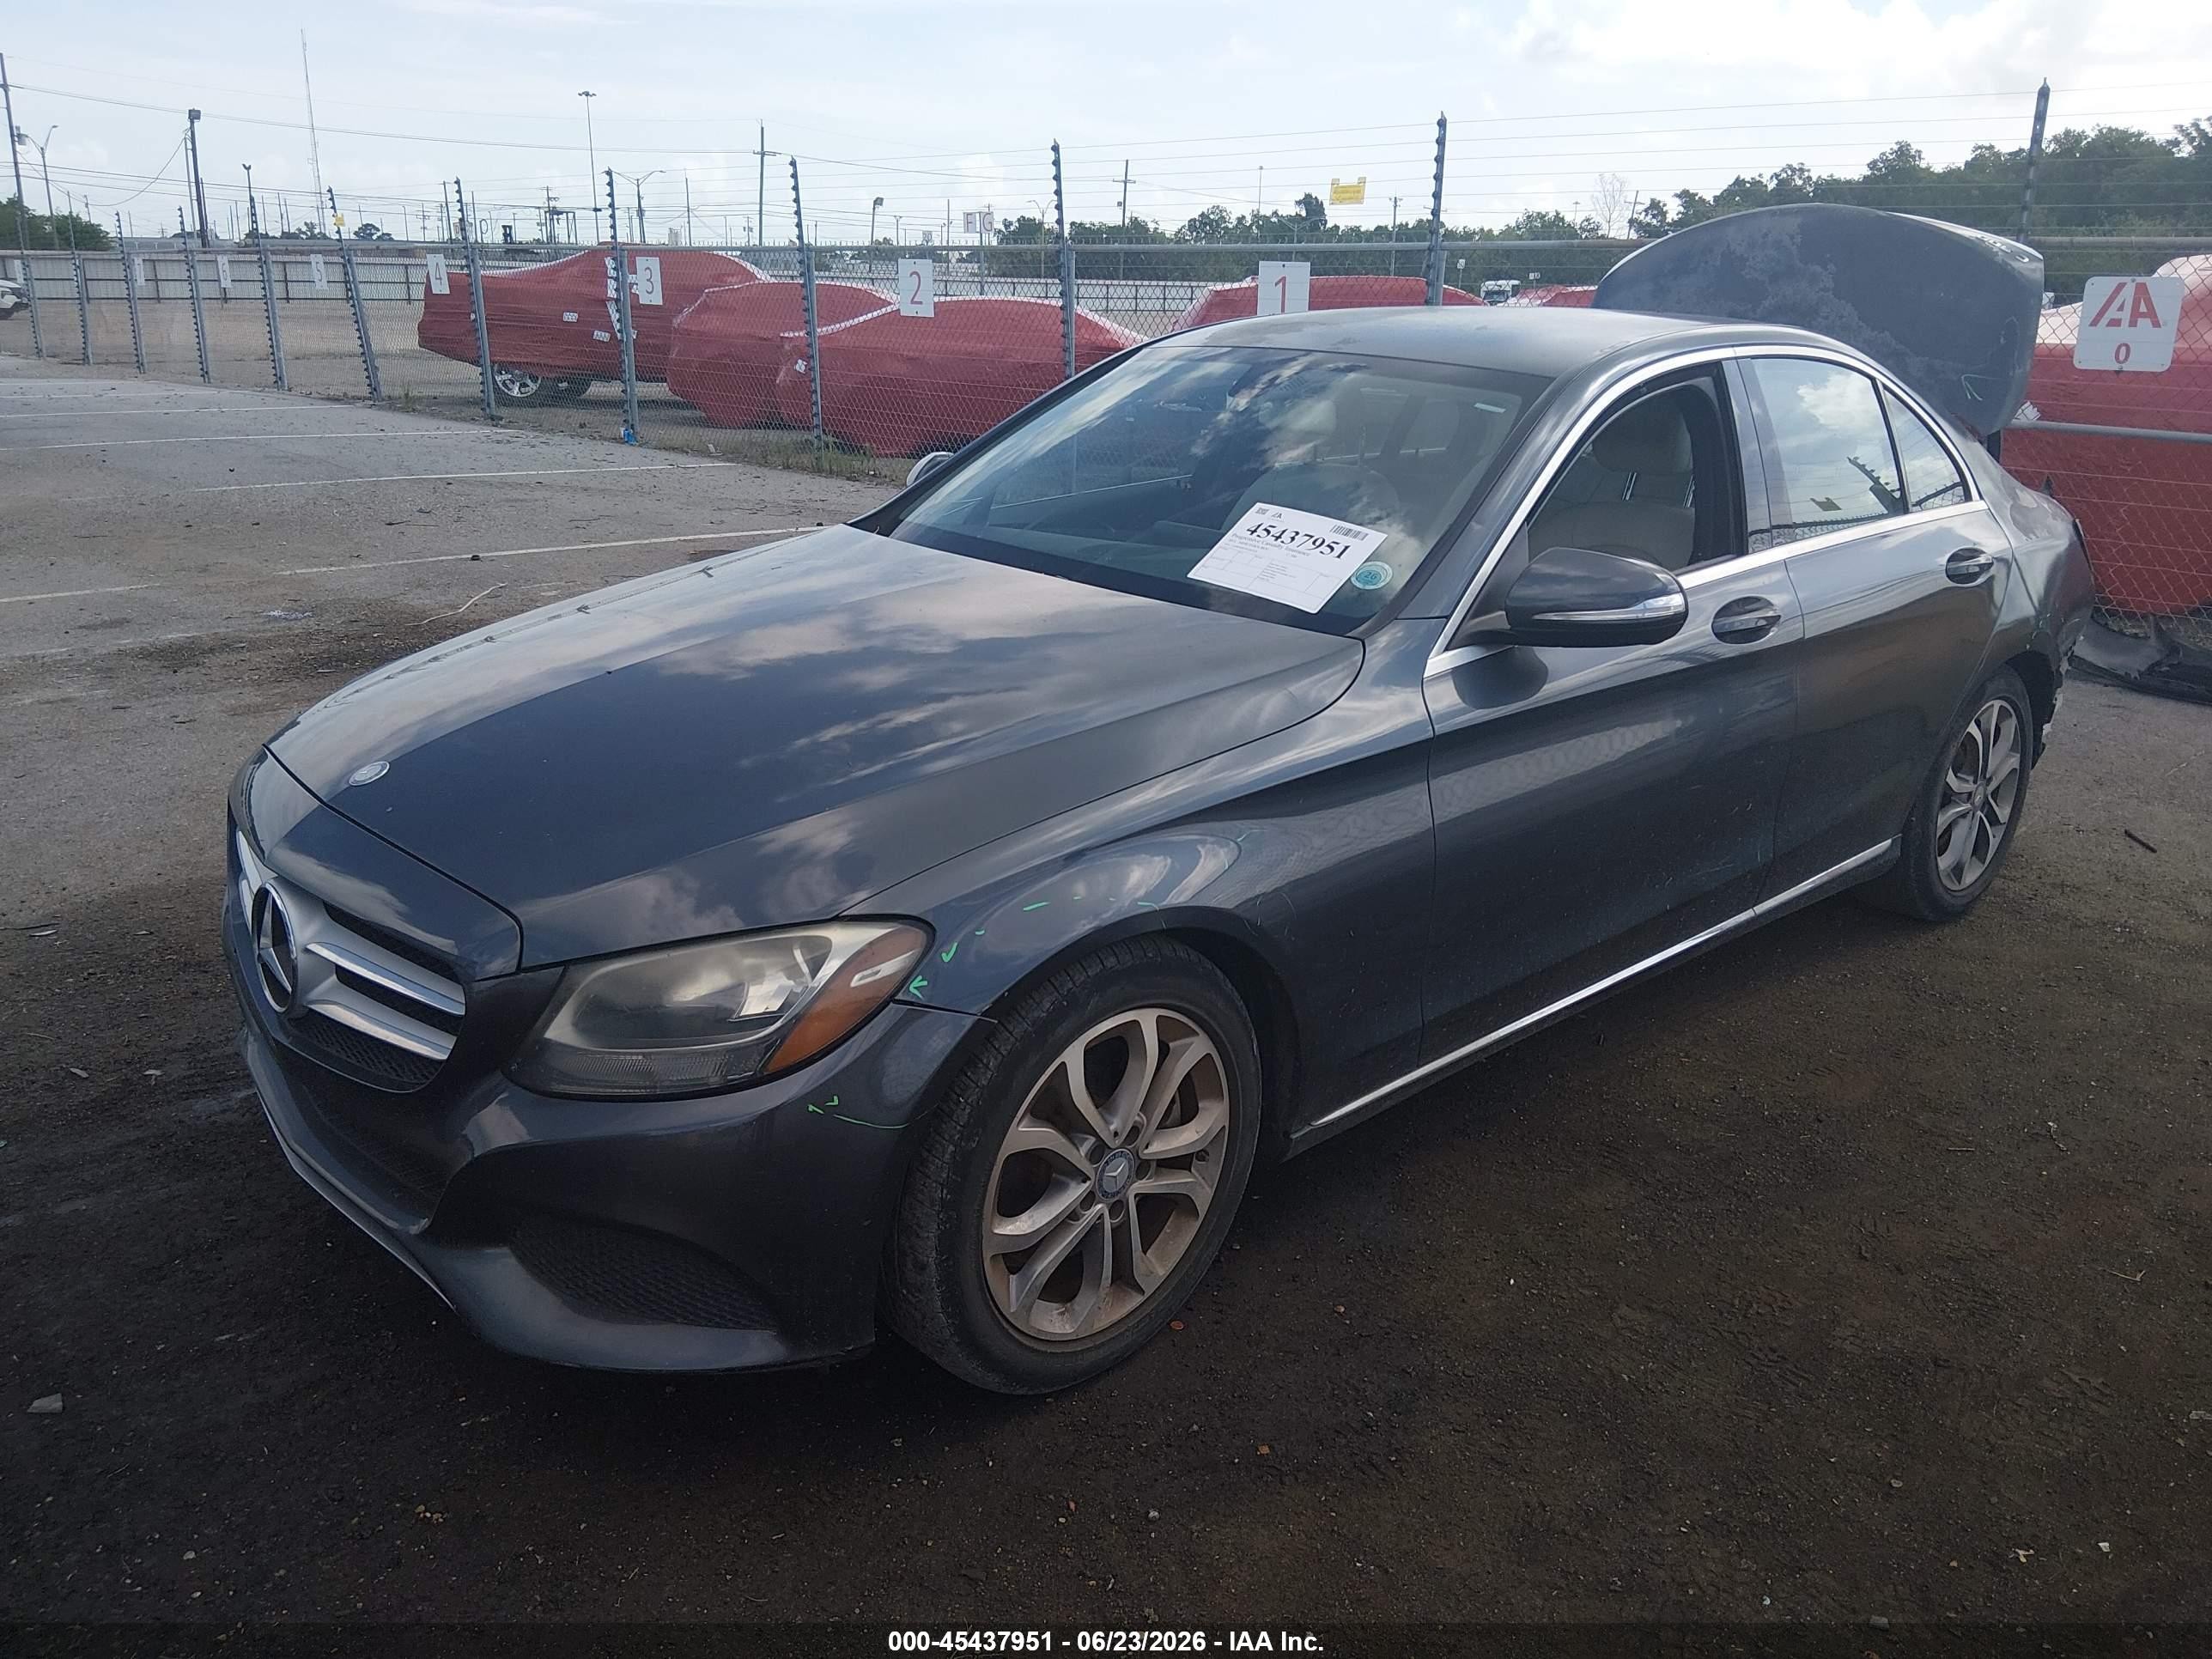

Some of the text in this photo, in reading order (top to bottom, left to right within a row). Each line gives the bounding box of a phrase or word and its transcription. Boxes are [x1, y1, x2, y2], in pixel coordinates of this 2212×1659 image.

[966, 213, 973, 233] F
[982, 213, 993, 232] G
[222, 262, 228, 281] 6
[315, 261, 322, 282] 5
[434, 262, 442, 285] 4
[644, 266, 654, 295] 3
[909, 270, 924, 306] 2
[1274, 275, 1287, 314] 1
[2114, 343, 2131, 364] 0
[1246, 521, 1352, 559] 45437951
